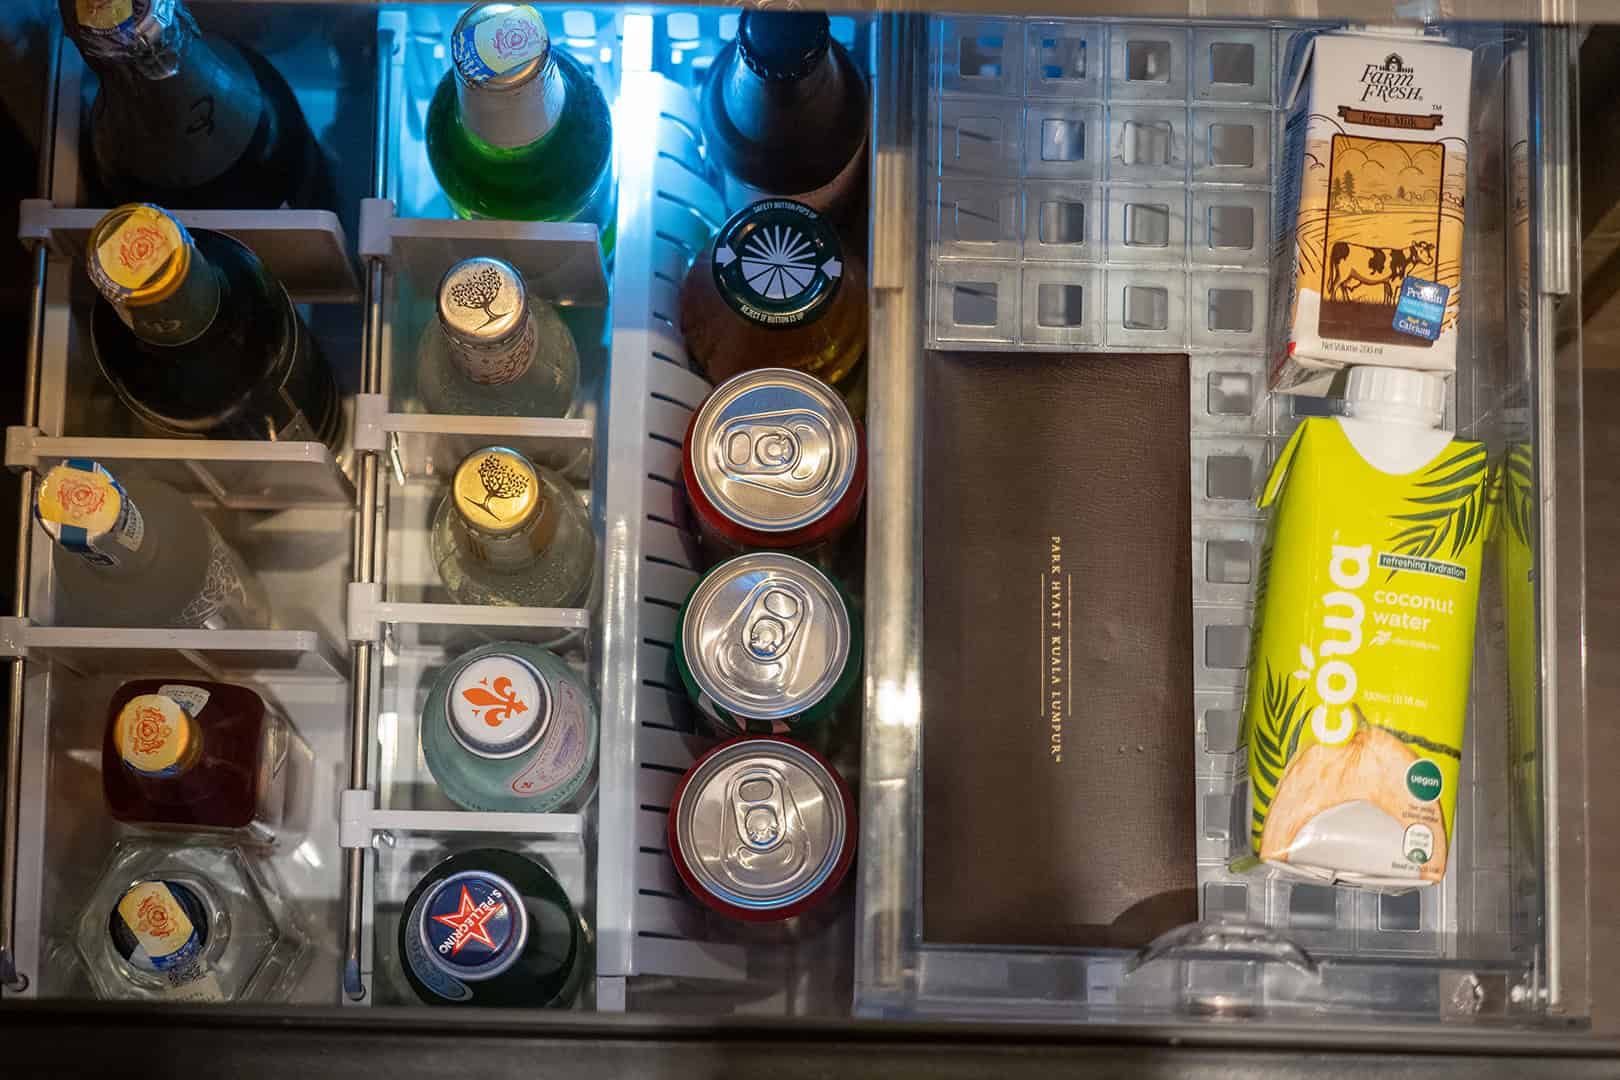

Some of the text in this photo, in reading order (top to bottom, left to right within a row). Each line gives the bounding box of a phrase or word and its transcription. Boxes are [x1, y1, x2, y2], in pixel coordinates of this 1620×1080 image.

[1362, 111, 1417, 128] Fresh Milk
[1051, 536, 1061, 575] PARK
[1382, 556, 1465, 578] refreshing hydration
[1051, 581, 1061, 630] HYATT
[1373, 589, 1455, 616] coconut
[1373, 611, 1432, 632] water
[1051, 635, 1061, 684] KUALA
[1311, 543, 1372, 744] cowa
